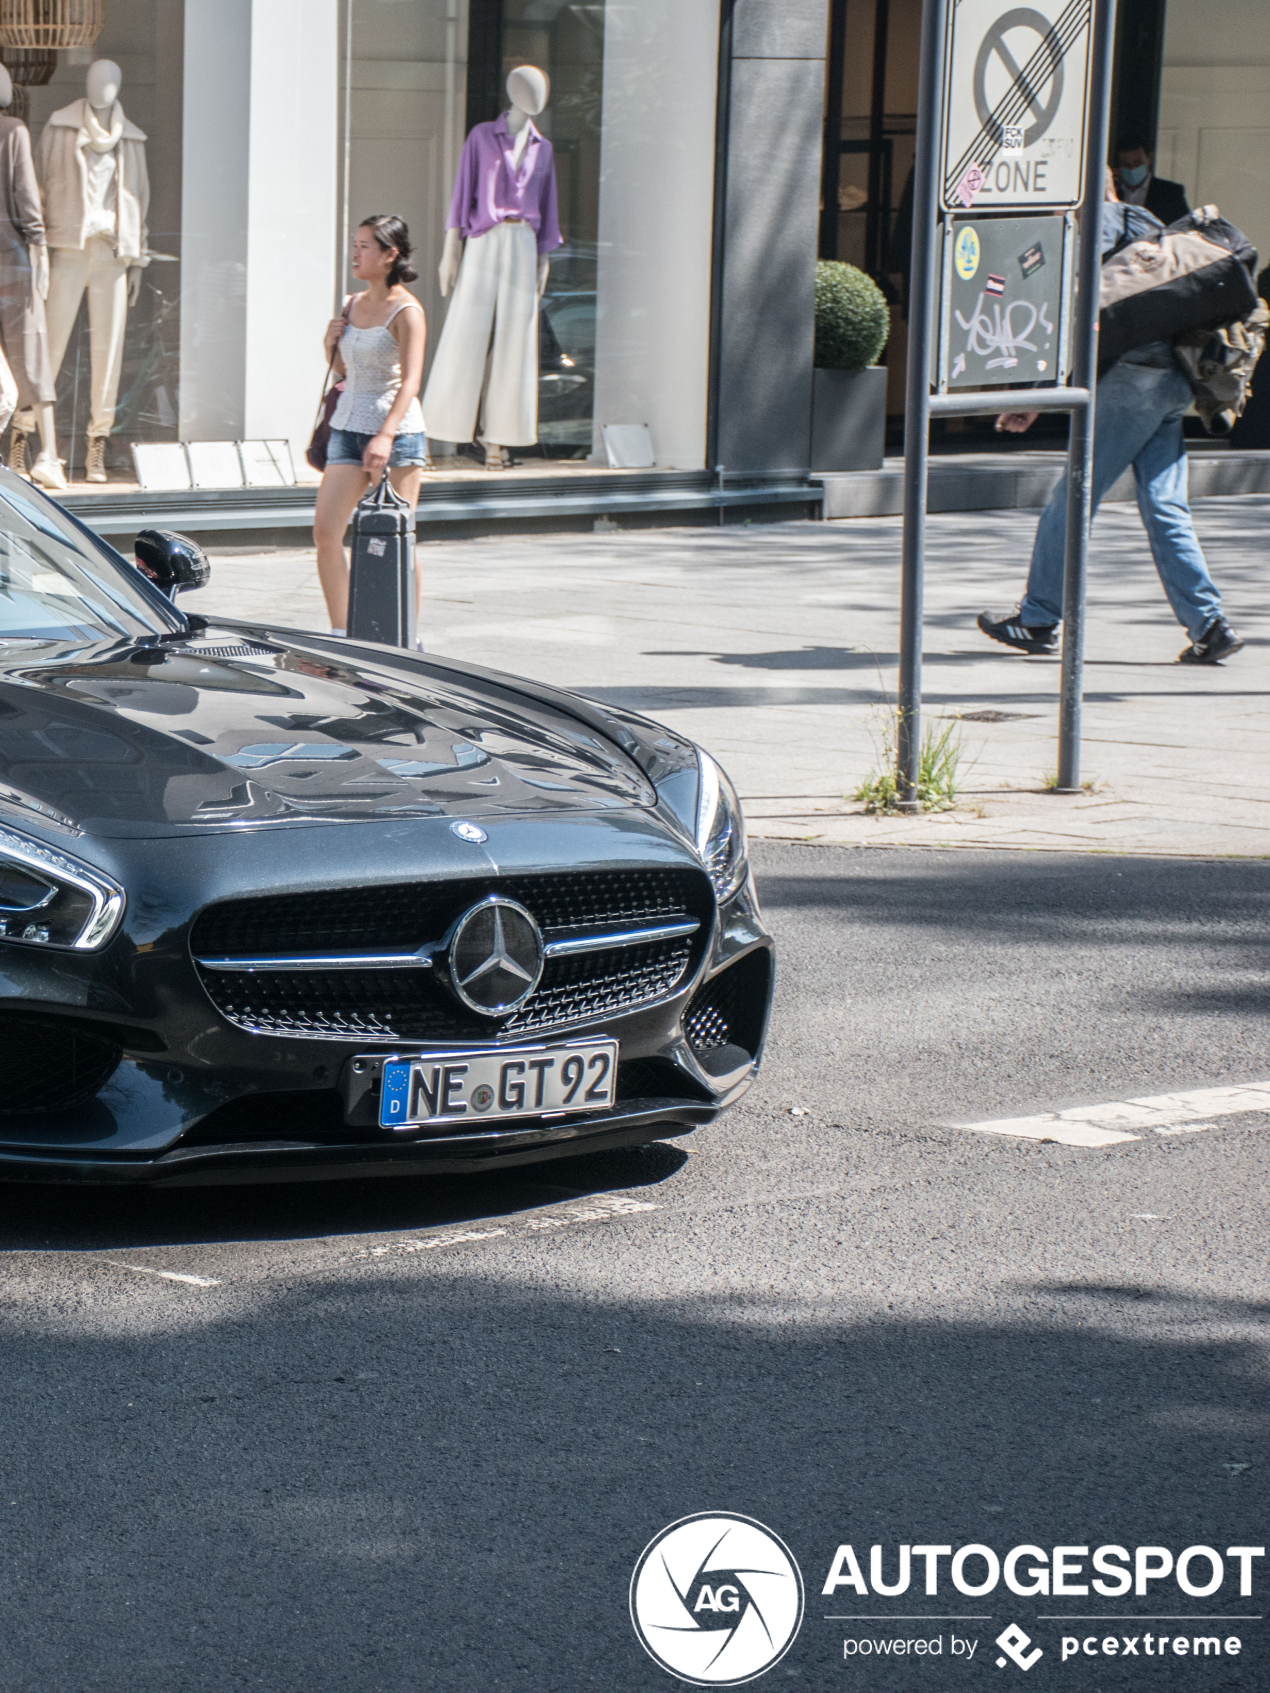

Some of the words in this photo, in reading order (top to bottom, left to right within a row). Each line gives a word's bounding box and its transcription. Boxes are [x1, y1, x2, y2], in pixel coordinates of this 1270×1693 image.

[1003, 138, 1024, 149] SUV
[1004, 127, 1024, 138] FCK
[979, 160, 1048, 194] ZONE
[389, 1099, 401, 1115] D
[409, 1063, 470, 1120] NE
[497, 1056, 556, 1111] GT
[560, 1051, 611, 1105] 92
